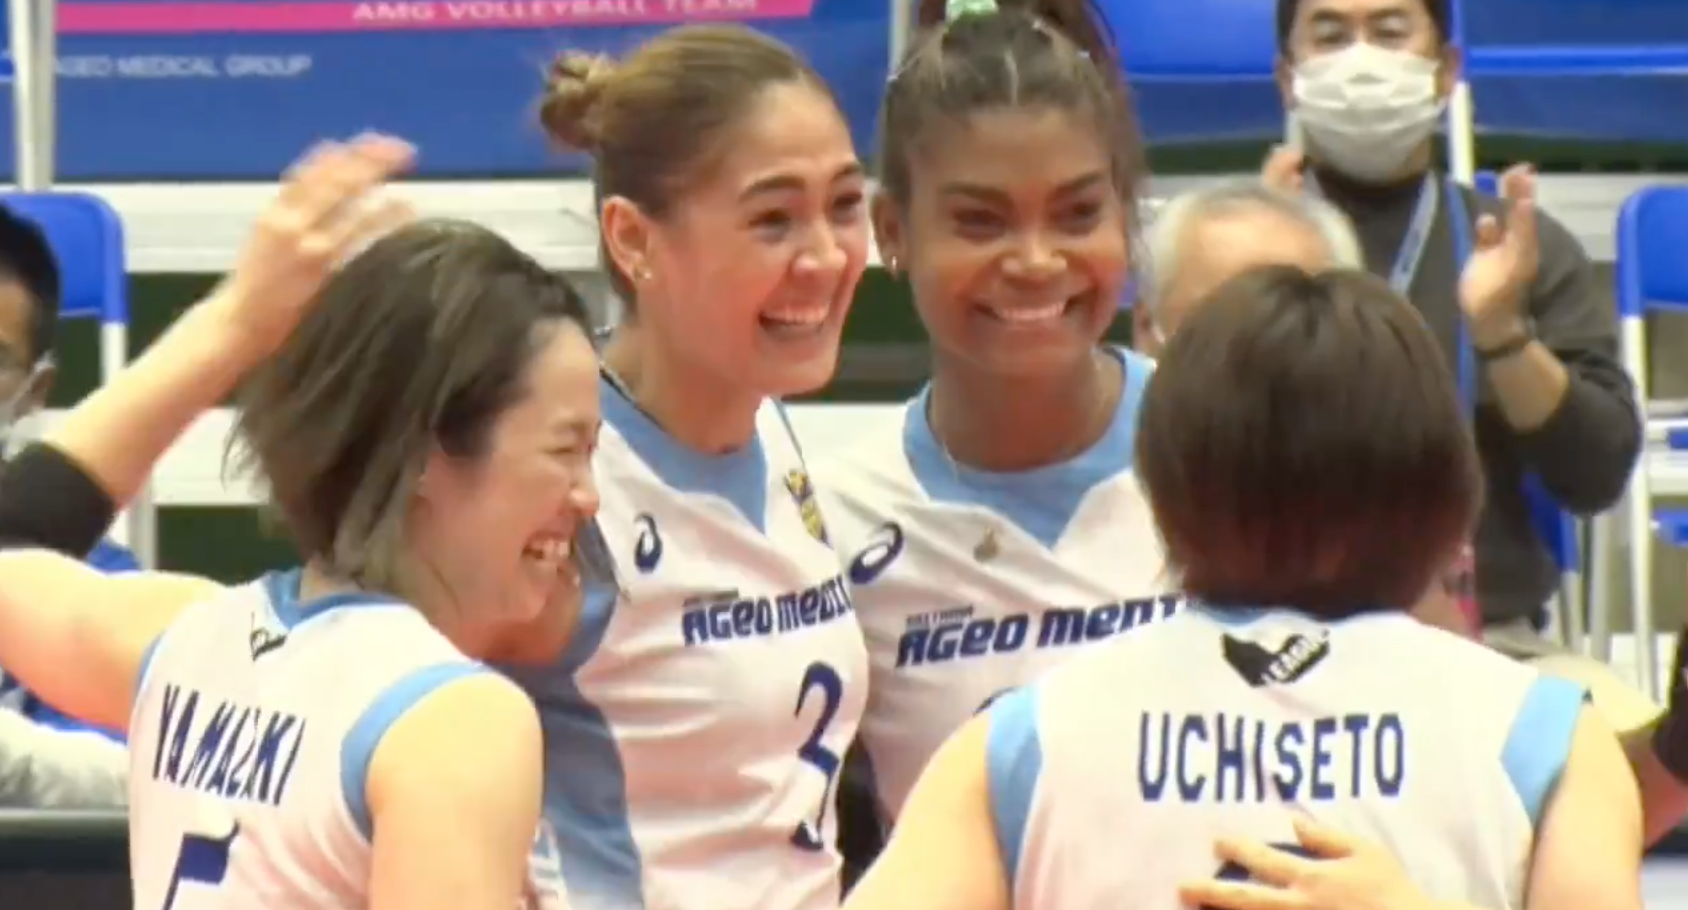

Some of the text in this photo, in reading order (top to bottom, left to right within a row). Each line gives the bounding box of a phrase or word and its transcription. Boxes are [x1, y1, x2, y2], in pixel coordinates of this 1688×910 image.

[353, 0, 757, 21] AMG VOLLEYBALL TEAM
[116, 54, 220, 77] MEDICAL
[224, 54, 312, 77] GROUP
[1138, 711, 1405, 803] UCHISETO
